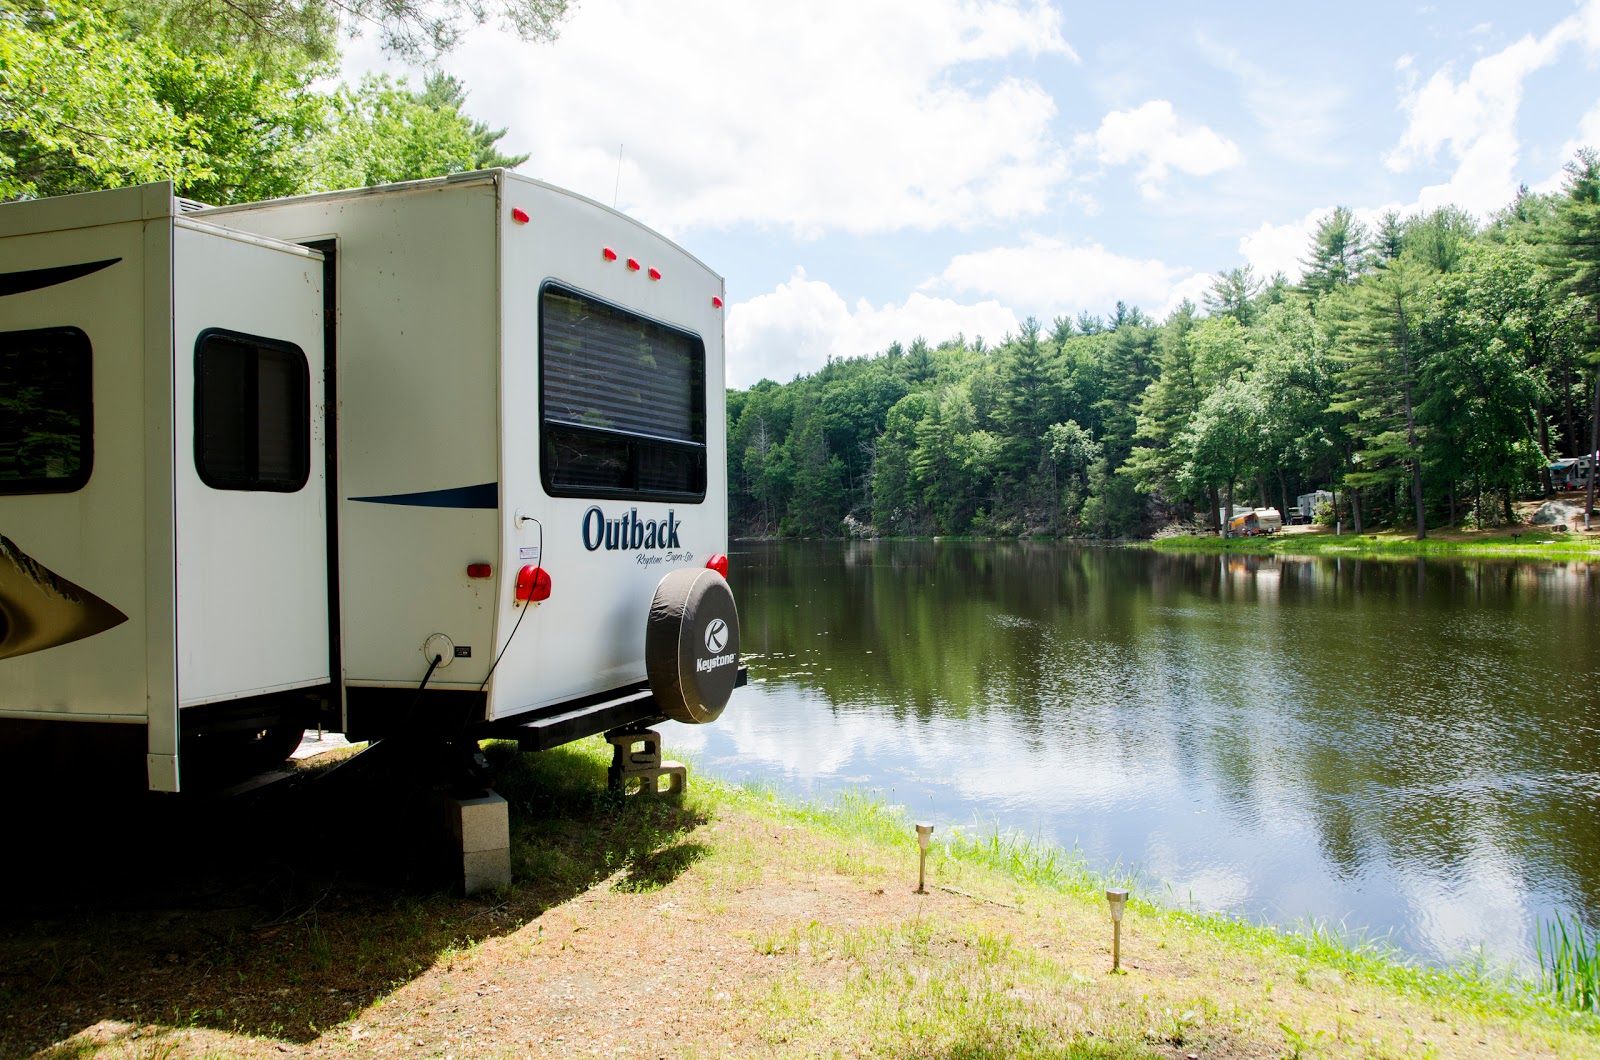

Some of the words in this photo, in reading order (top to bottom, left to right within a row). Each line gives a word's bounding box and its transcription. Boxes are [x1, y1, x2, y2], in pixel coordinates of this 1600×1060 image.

[582, 505, 681, 551] Outback
[636, 553, 662, 569] Keystone
[696, 654, 735, 673] Keystone
